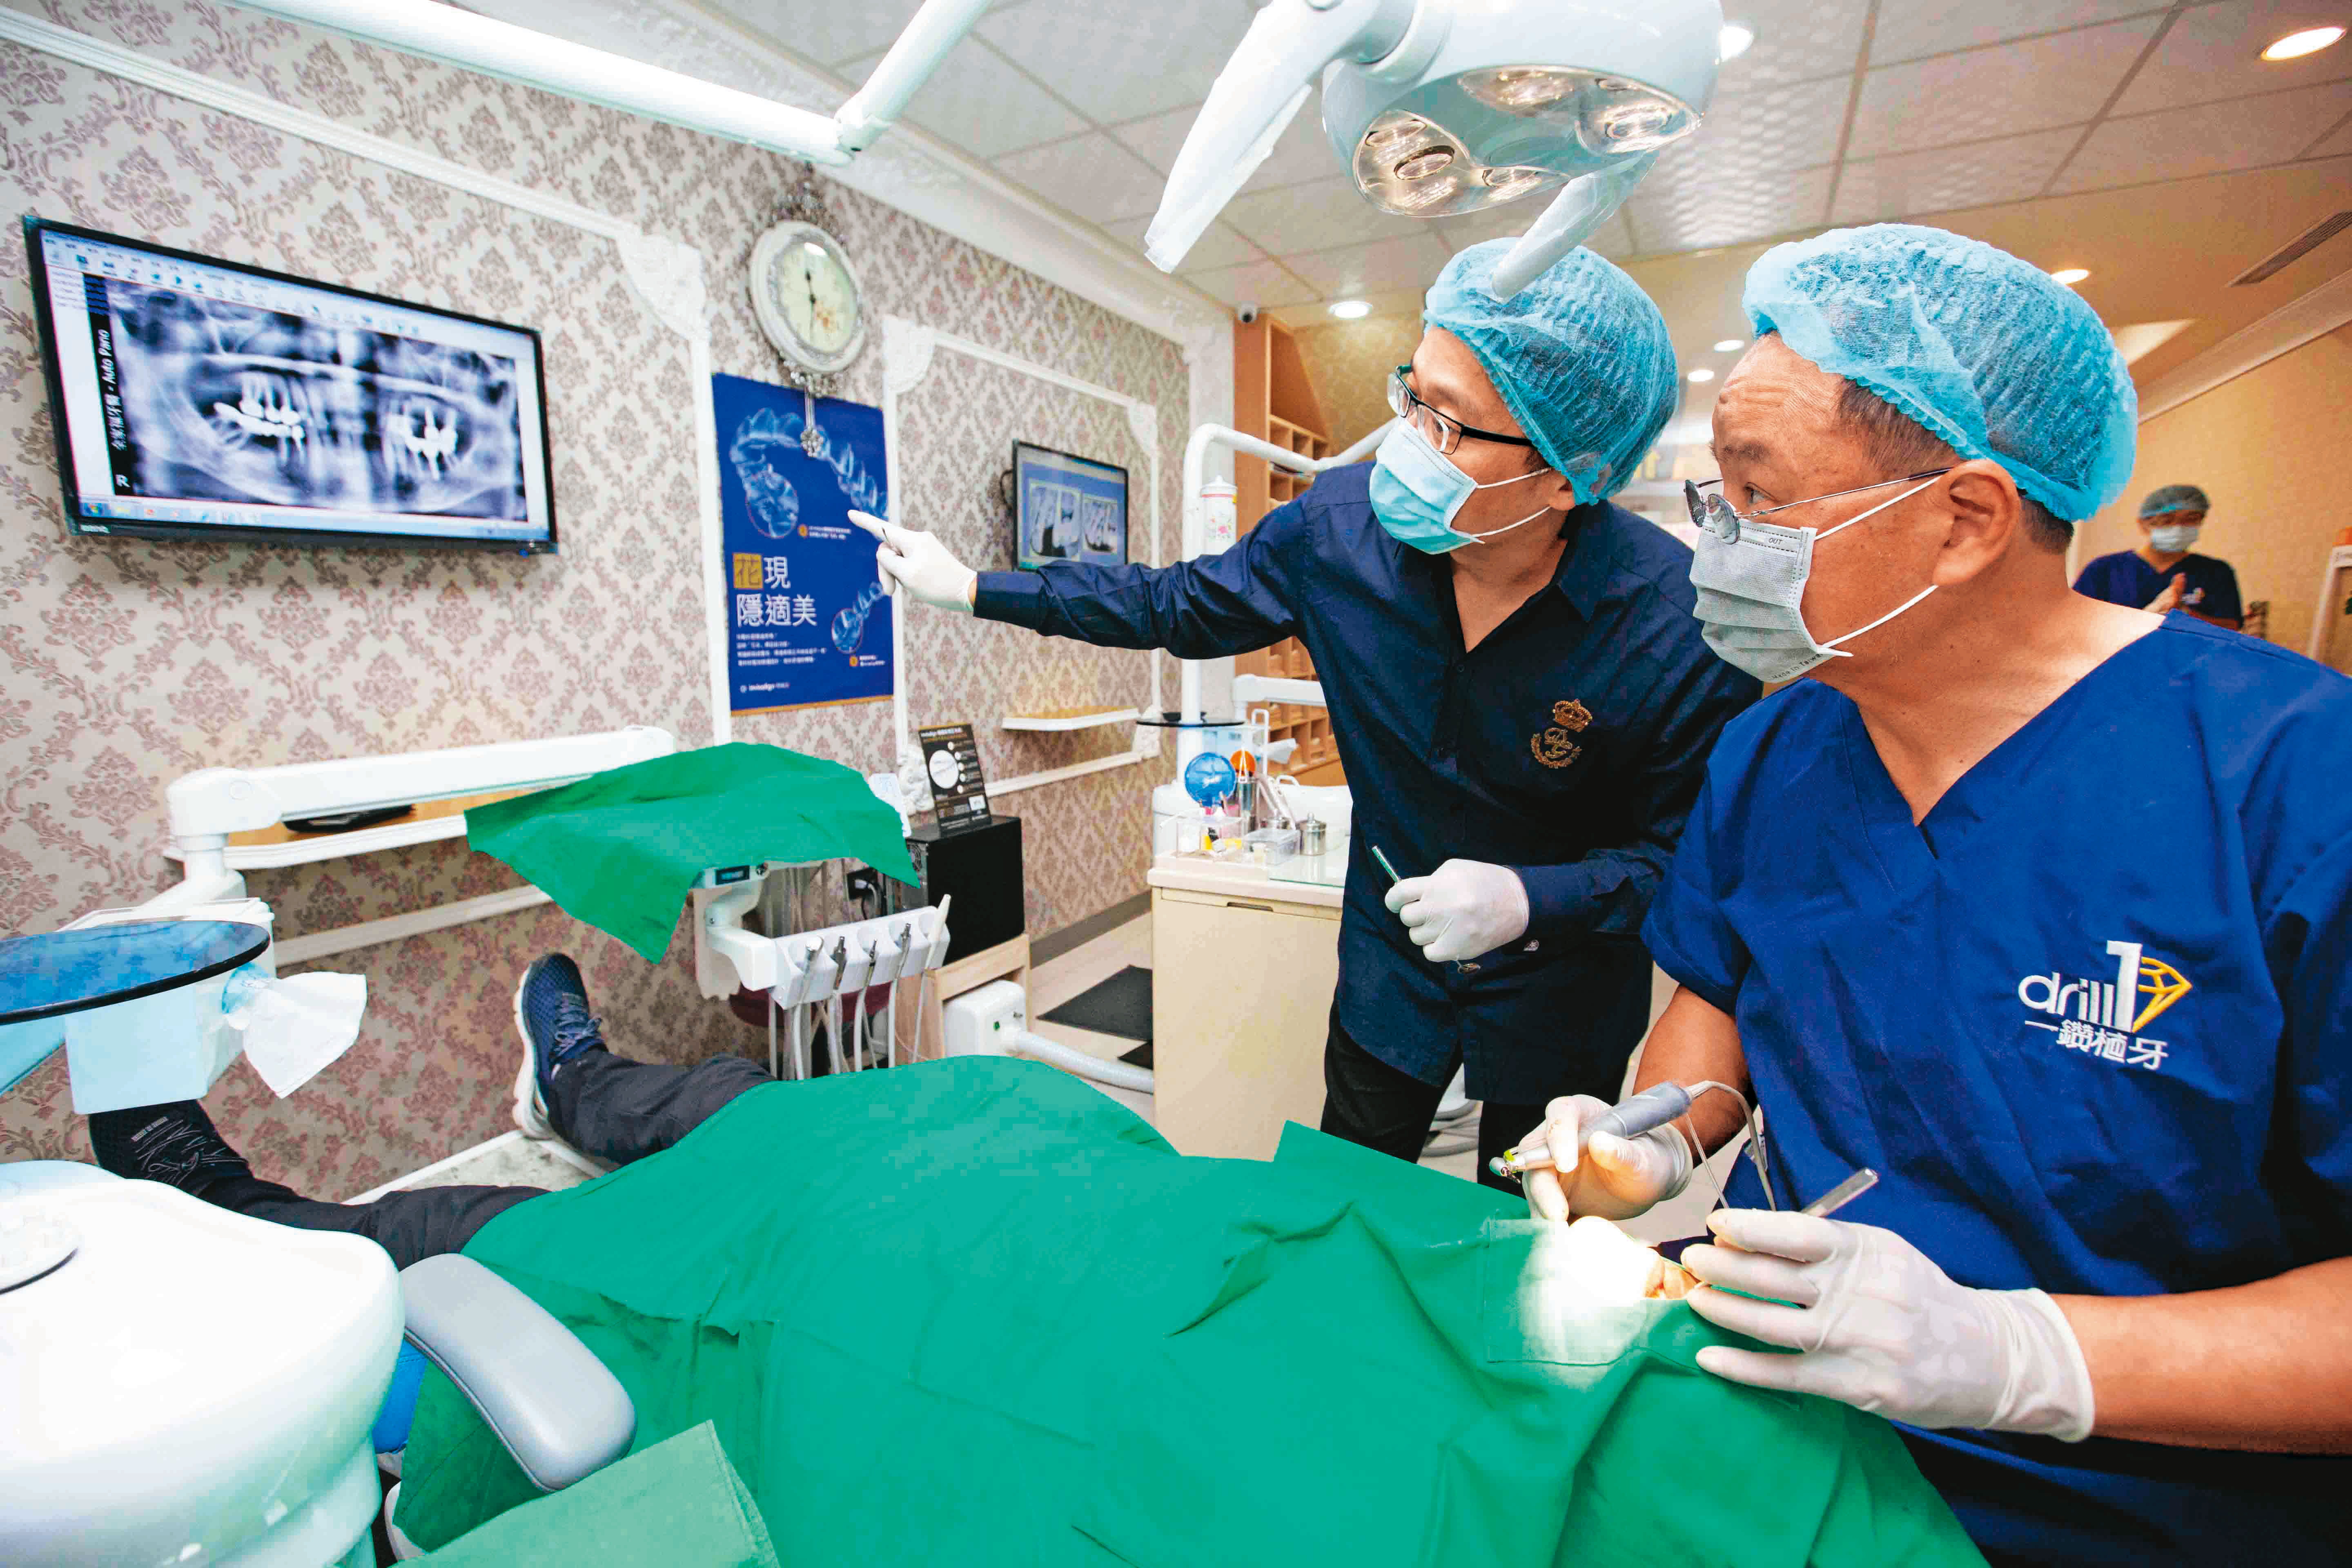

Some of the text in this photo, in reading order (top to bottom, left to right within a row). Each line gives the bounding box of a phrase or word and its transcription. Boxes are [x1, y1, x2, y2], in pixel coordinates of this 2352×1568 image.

[98, 329, 112, 356] Pano
[101, 358, 116, 384] Auto
[116, 474, 131, 488] R
[734, 555, 791, 589] 花現
[737, 593, 817, 628] 隱適美
[2025, 1019, 2169, 1070] 一鑽植牙
